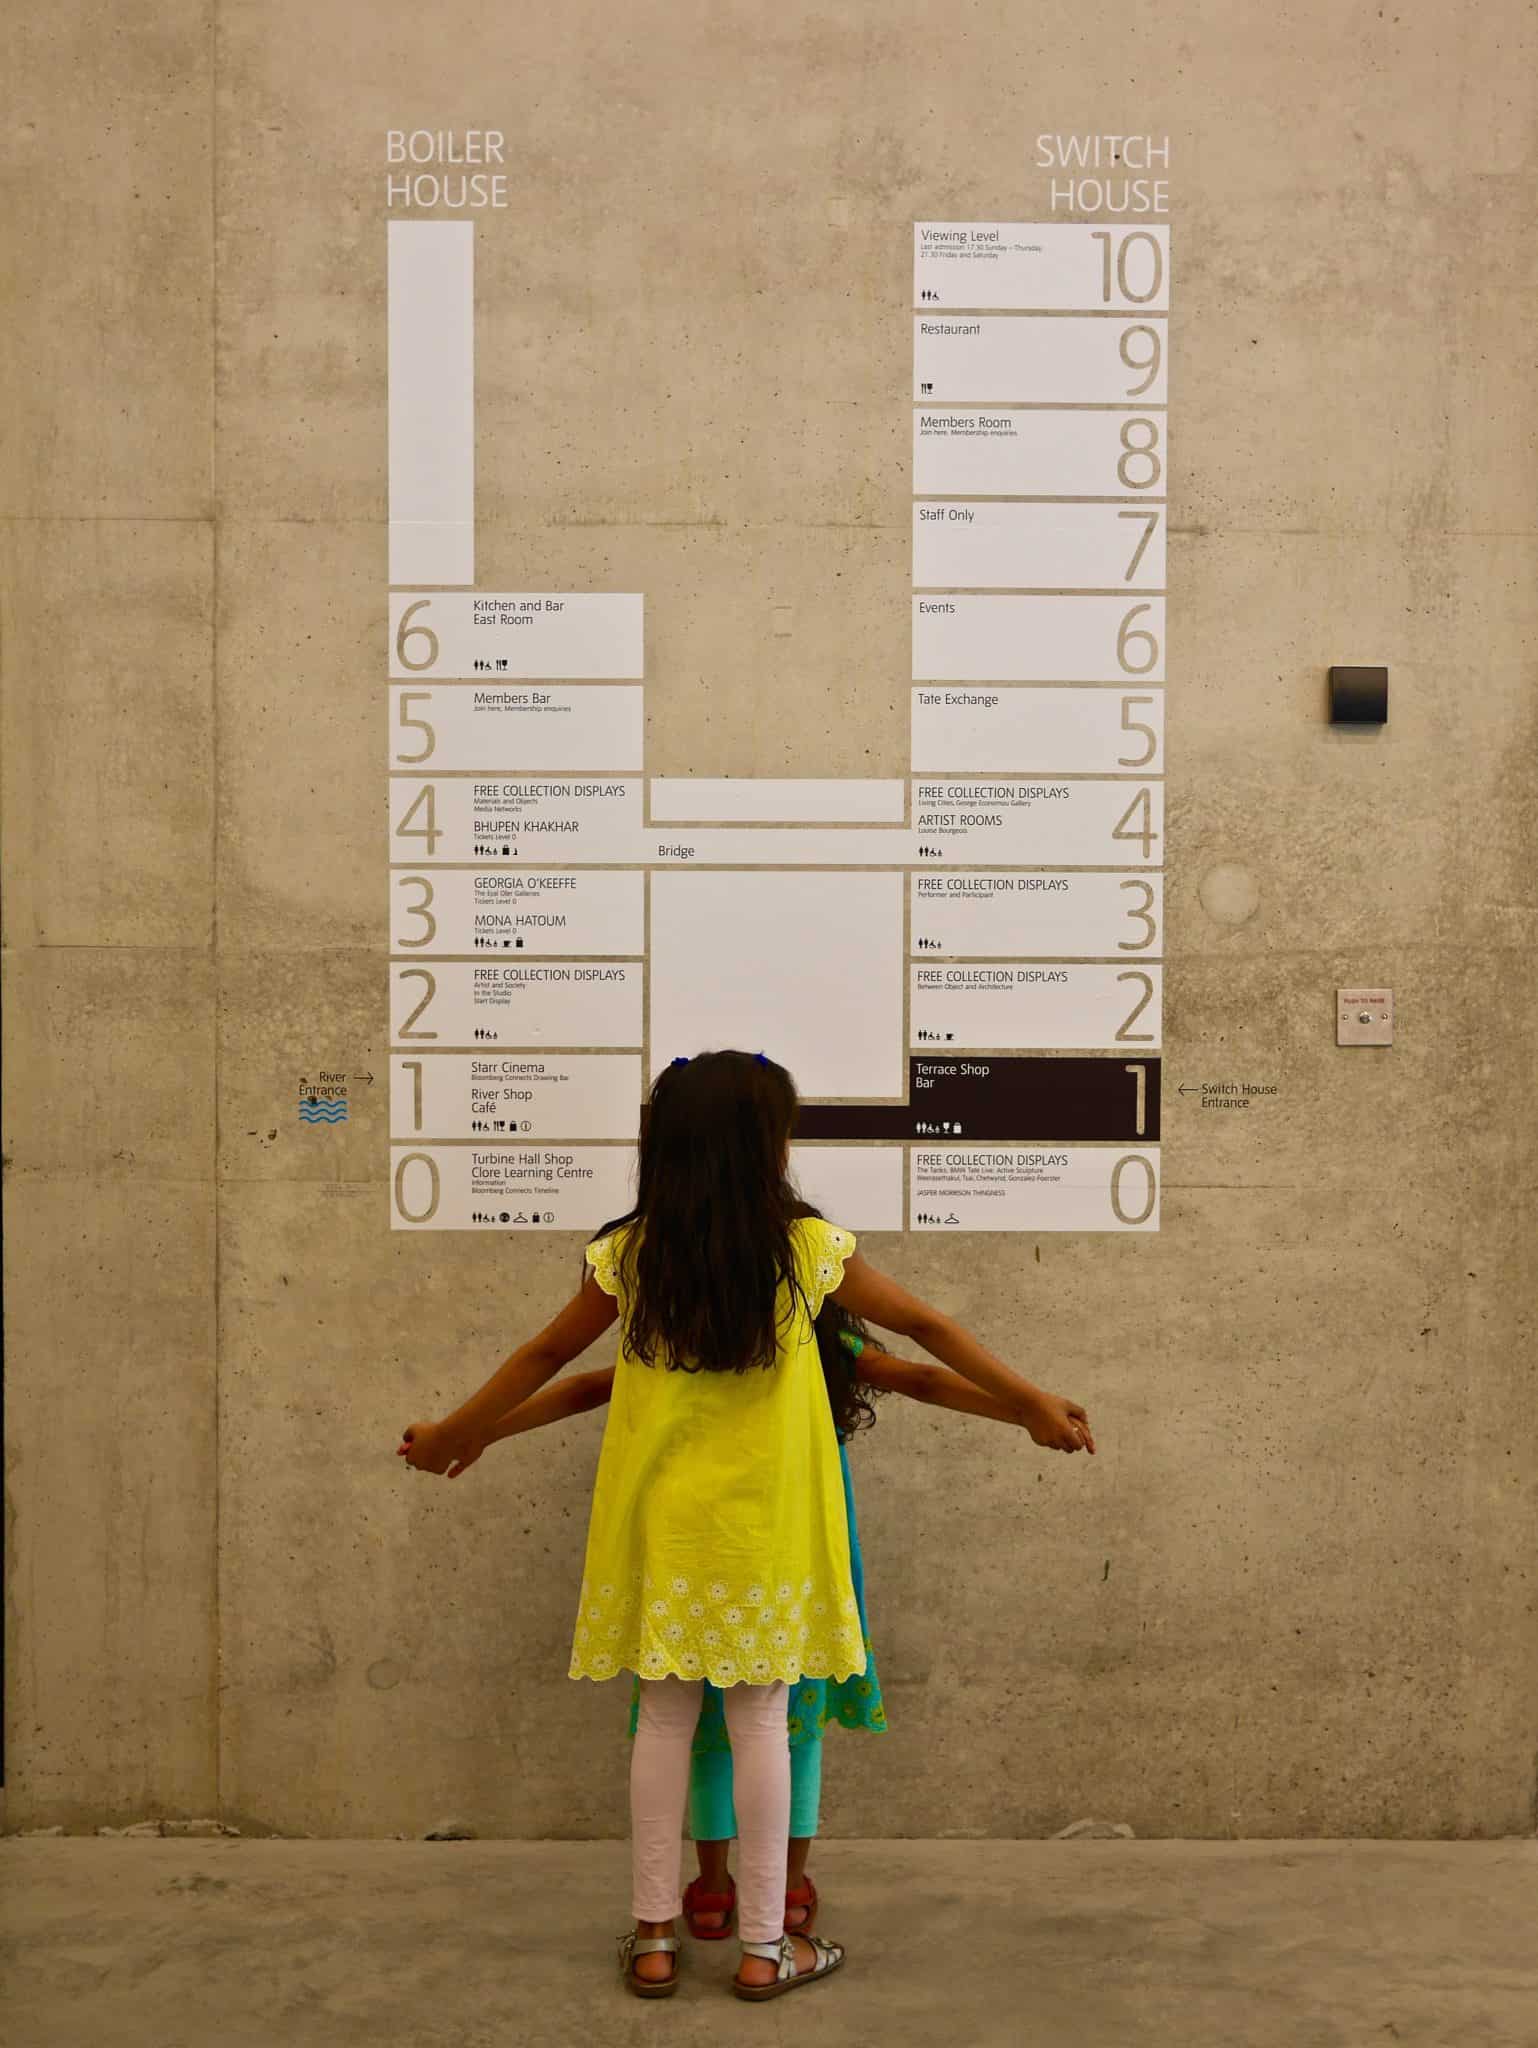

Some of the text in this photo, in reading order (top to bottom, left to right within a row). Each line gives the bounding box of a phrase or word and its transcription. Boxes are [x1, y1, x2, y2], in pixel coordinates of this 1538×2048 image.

[387, 130, 505, 163] BOILER
[1036, 134, 1169, 168] SWITCH
[387, 174, 508, 208] HOUSE
[1051, 179, 1169, 213] HOUSE
[920, 229, 999, 244] Viewing Level
[985, 244, 1007, 252] Sunday
[1014, 244, 1043, 252] Thursday
[973, 252, 999, 260] Saturday
[1091, 231, 1162, 304] 10
[920, 323, 981, 336] Restaurant
[1119, 325, 1161, 396] 9
[920, 416, 1012, 428] Members Room
[1117, 418, 1161, 489] 8
[920, 510, 975, 524] Staff Only
[1118, 511, 1160, 582] 7
[473, 600, 566, 612] Kitchen and Bar
[919, 602, 956, 614] Events
[473, 614, 534, 626] East Room
[396, 600, 439, 671] 6
[1116, 604, 1159, 674] 6
[473, 692, 551, 704] Members Bar
[918, 693, 999, 708] Tate Exchange
[396, 692, 436, 764] 5
[1118, 696, 1156, 767] 5
[474, 785, 626, 797] FREE COLLECTION DISPLAYS
[918, 787, 1070, 799] FREE COLLECTION DISPLAYS
[396, 784, 443, 856] 4
[474, 820, 580, 832] BHUPEN KHAKHAR
[918, 814, 1002, 826] ARTIST ROOMS
[1112, 787, 1158, 858] 4
[658, 844, 695, 859] Bridge
[474, 877, 576, 889] GEORGIA O'KEEFFE
[918, 879, 1069, 890] FREE COLLECTION DISPLAYS
[398, 876, 436, 948] 3
[1117, 880, 1156, 950] 3
[474, 915, 566, 926] MONA HATOUM
[474, 970, 626, 981] FREE COLLECTION DISPLAYS
[918, 971, 1068, 982] FREE COLLECTION DISPLAYS
[398, 968, 438, 1039] 2
[1115, 971, 1154, 1042] 2
[472, 1062, 545, 1072] Starr Cinema
[916, 1064, 990, 1078] Terrace Shop
[319, 1072, 347, 1082] River
[916, 1077, 935, 1089] Bar
[299, 1084, 348, 1096] Entrance
[402, 1061, 422, 1131] 1
[472, 1088, 533, 1102] River Shop
[1201, 1083, 1278, 1096] Switch House
[1125, 1064, 1146, 1135] 1
[1201, 1096, 1250, 1108] Entrance
[472, 1102, 496, 1113] Café
[472, 1153, 574, 1166] Turbine Hall Shop
[917, 1154, 1068, 1166] FREE COLLECTION DISPLAYS
[472, 1166, 593, 1180] Clore Learning Centre
[395, 1152, 440, 1223] 0
[1110, 1154, 1156, 1224] 0
